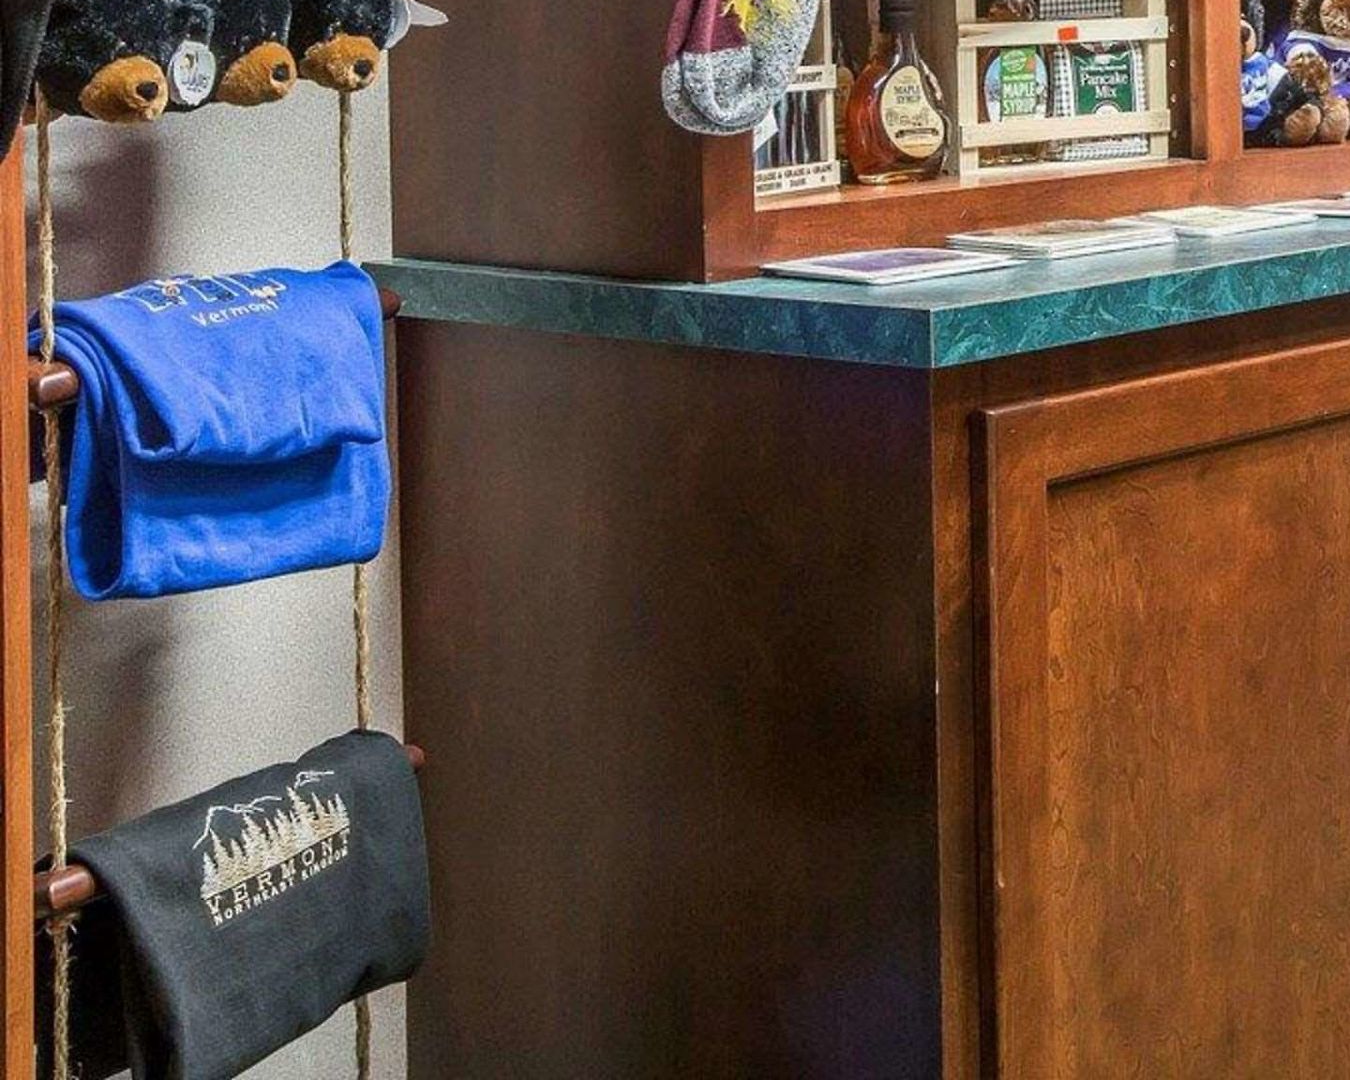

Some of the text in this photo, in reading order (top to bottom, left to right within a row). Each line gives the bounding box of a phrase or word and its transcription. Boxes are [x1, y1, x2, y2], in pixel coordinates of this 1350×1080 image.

[1080, 72, 1129, 87] Pancake
[1002, 81, 1036, 99] MAPLE
[1094, 84, 1118, 99] Mix
[1002, 99, 1036, 115] SYRUP
[191, 299, 280, 327] Vermont
[206, 828, 349, 915] VERMONT
[213, 877, 296, 927] NORTHEAST
